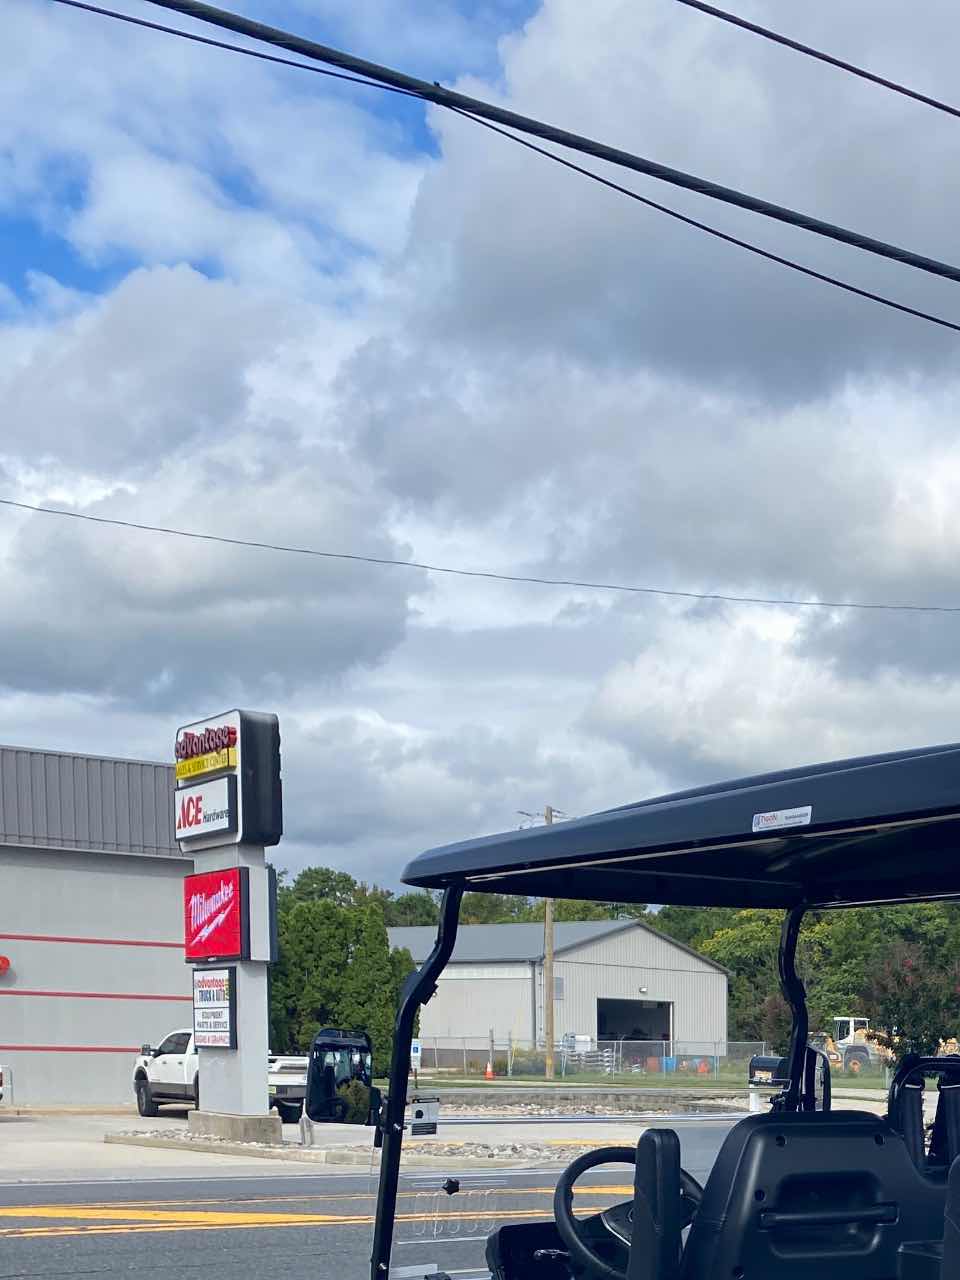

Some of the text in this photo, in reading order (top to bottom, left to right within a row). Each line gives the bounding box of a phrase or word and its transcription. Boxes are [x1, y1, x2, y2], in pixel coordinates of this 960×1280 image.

[177, 795, 231, 830] ACE Hardware
[189, 879, 234, 933] Milwaukee
